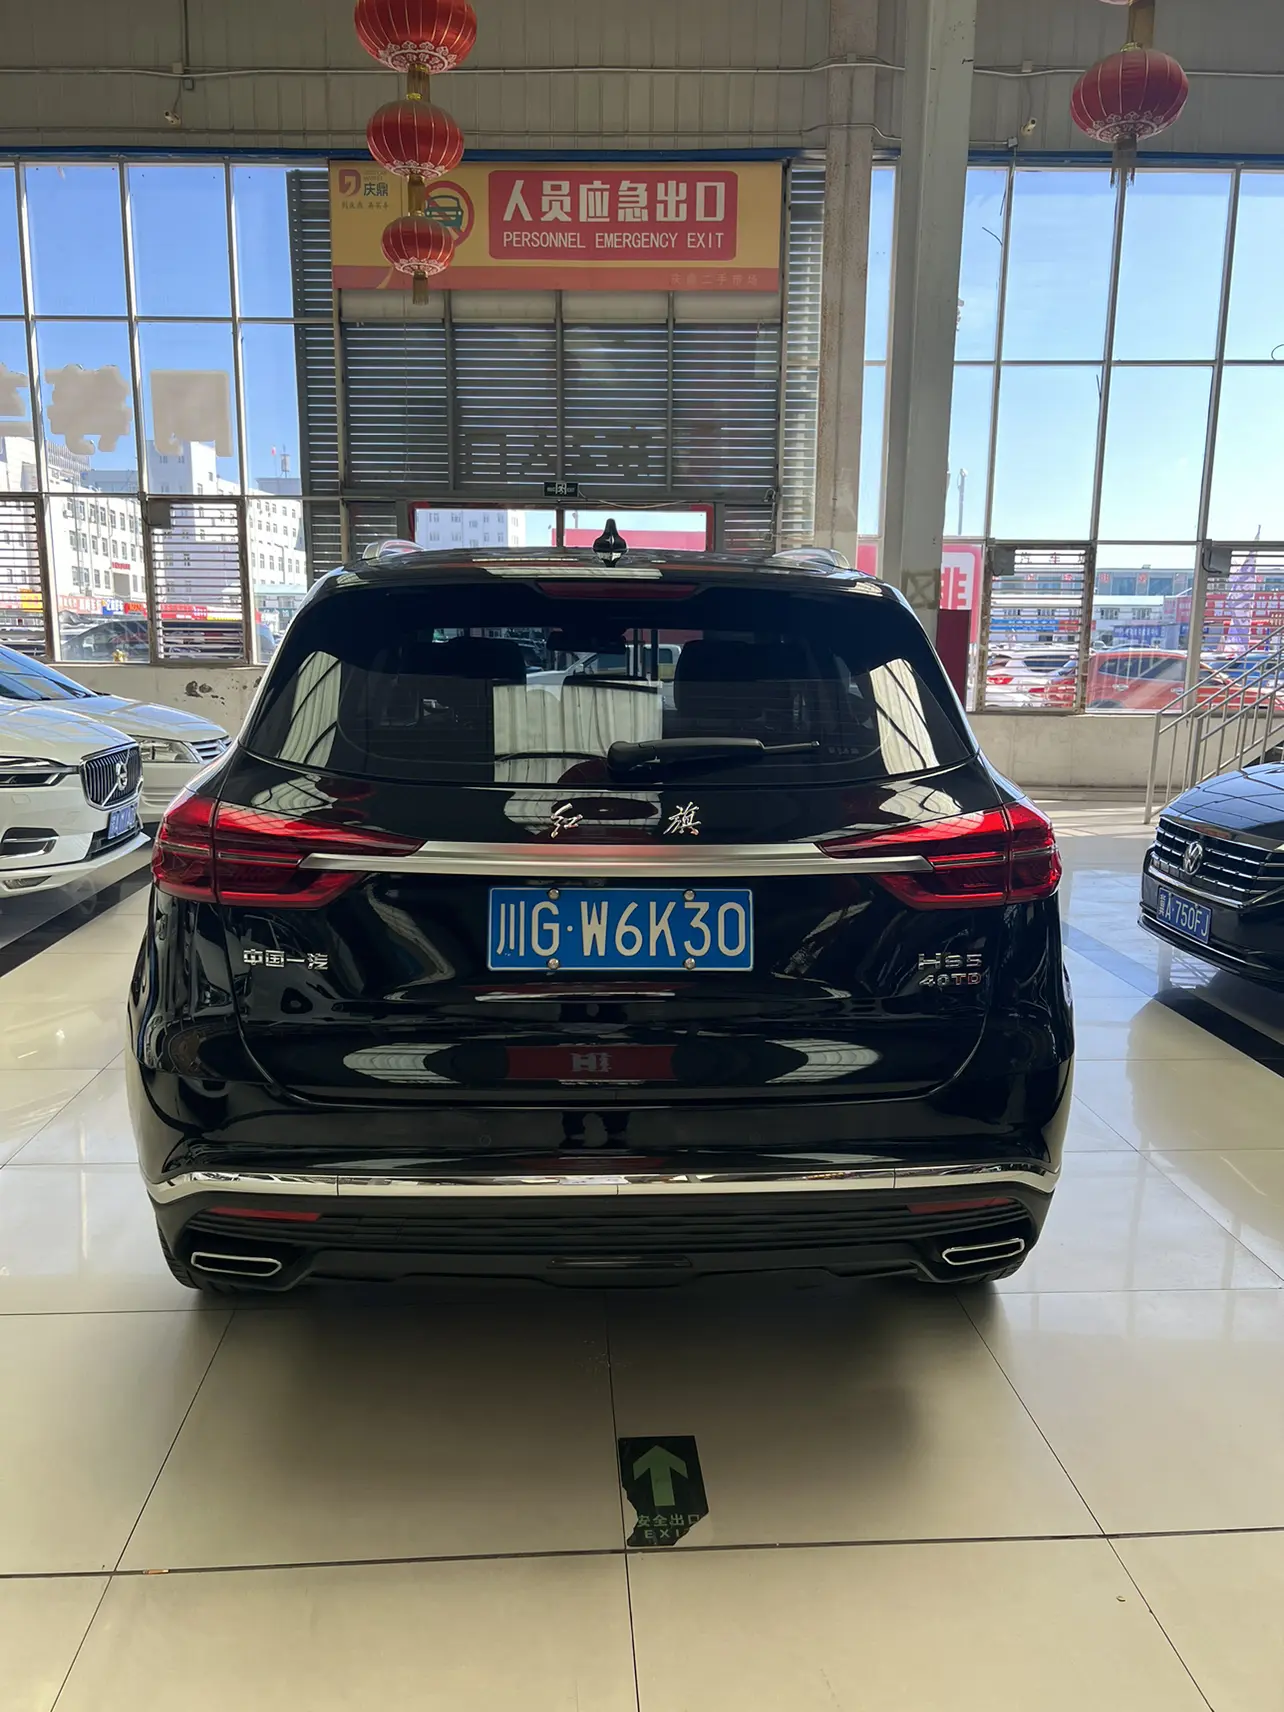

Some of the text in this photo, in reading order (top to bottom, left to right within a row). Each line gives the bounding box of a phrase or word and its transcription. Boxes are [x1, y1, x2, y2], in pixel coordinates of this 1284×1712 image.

[363, 182, 389, 197] 庆鼎
[503, 180, 725, 222] 人员应急出口
[503, 231, 724, 249] PERSONNEL EMERGENCY EXIT
[550, 801, 702, 839] 红旗
[243, 948, 328, 970] 中国一汽
[918, 953, 983, 970] HS5
[919, 972, 981, 987] 40TD
[637, 1514, 700, 1528] 安全出口
[644, 1528, 680, 1539] EXI
